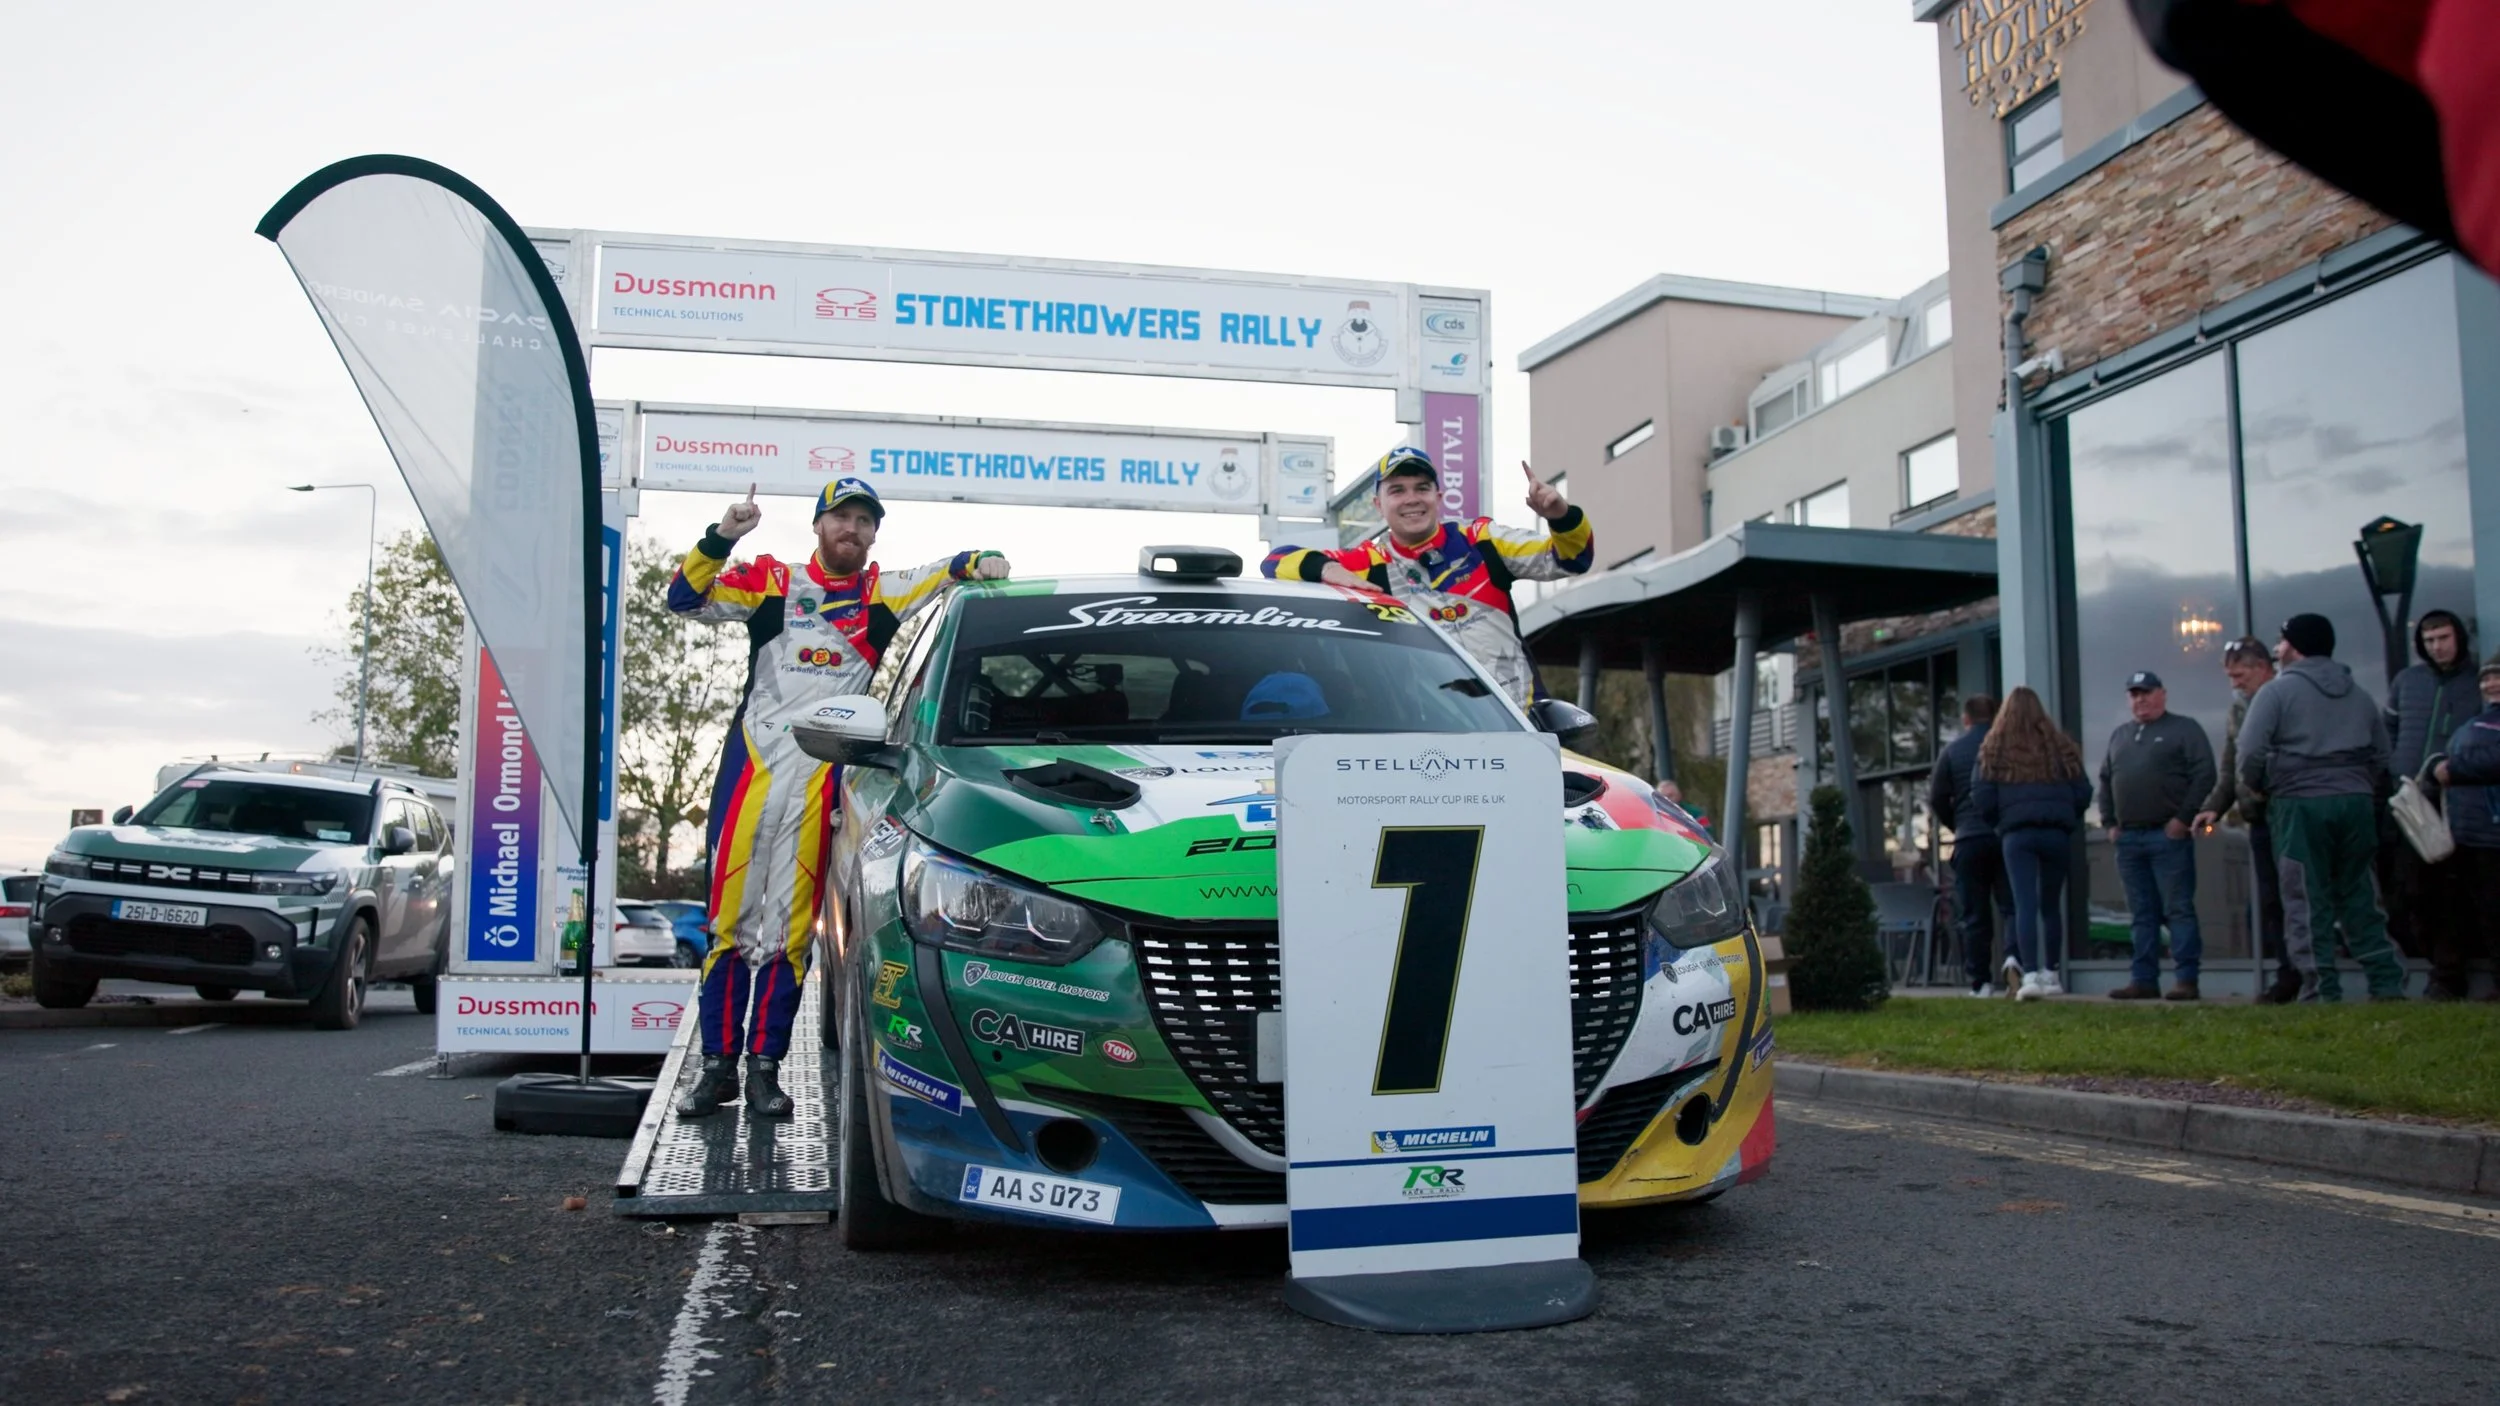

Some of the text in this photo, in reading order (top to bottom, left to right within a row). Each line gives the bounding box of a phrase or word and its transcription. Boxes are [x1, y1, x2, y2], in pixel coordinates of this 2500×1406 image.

[1960, 0, 2096, 92] HOTE
[614, 272, 776, 300] Dussmann
[613, 306, 744, 322] TECHNICAL SOLUTIONS
[815, 304, 877, 319] STS
[895, 293, 1322, 348] STONETHROWERS RALLY
[1444, 318, 1465, 330] cds
[655, 435, 778, 457] Dussmann
[655, 462, 754, 474] TECHNICAL SOLUTIONS
[808, 460, 855, 472] STS
[870, 449, 1200, 486] STONETHROWERS RALLY
[1442, 416, 1464, 523] TALBOT
[1023, 596, 1382, 635] Streamline
[1366, 604, 1418, 625] 29
[817, 708, 854, 720] OEM
[492, 714, 523, 812] Ormond
[1336, 758, 1506, 771] STELLANTIS
[1337, 794, 1506, 805] MOTORSPORT RALLY CUP IRE & UK
[489, 822, 521, 917] Michael
[125, 905, 199, 924] 251-D-16620
[1371, 825, 1486, 1096] 1
[1676, 963, 1699, 976] LOUGH
[984, 968, 1110, 1002] LOUGH OWEL MOTORS
[631, 1017, 682, 1029] STS
[1672, 1001, 1735, 1036] CA HIRE
[457, 1027, 570, 1037] TECHNICAL SOLUTIONS
[970, 1008, 1079, 1050] CA HIRE
[1106, 1043, 1134, 1061] TOW
[886, 1067, 949, 1101] MICHELIN
[1402, 1130, 1489, 1146] MICHELIN
[965, 1184, 977, 1194] SK
